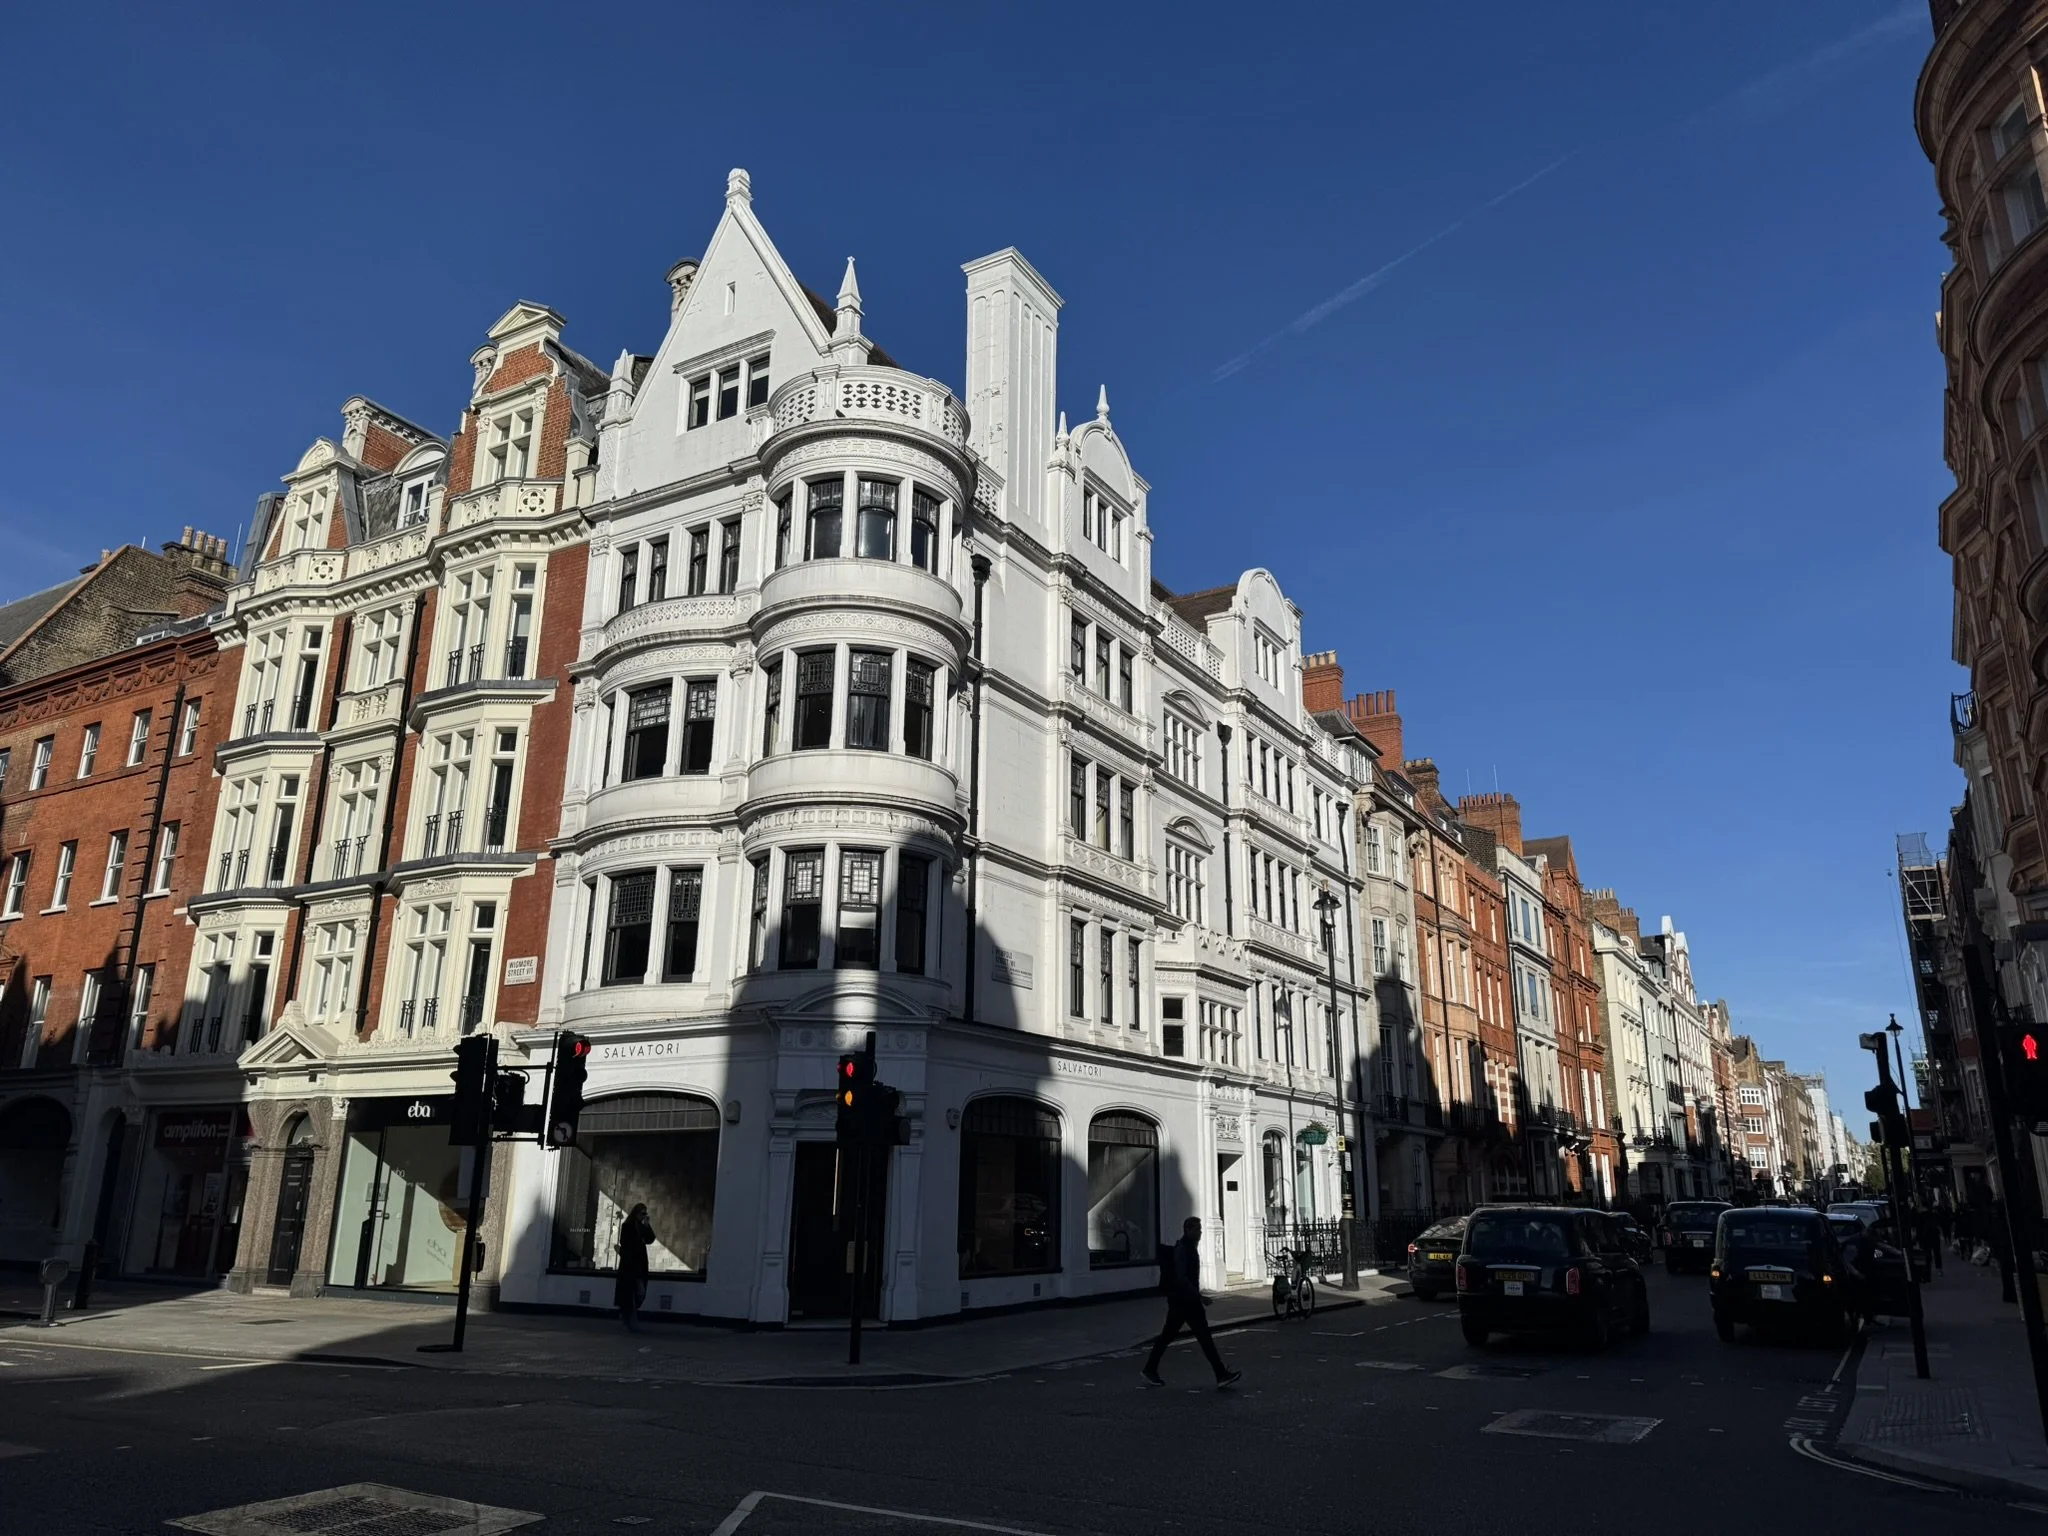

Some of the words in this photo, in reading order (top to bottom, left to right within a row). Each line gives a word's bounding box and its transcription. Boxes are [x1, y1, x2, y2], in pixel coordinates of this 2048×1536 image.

[509, 959, 533, 968] WIGMORE
[507, 967, 525, 977] STREET
[603, 1043, 680, 1059] SALVATORI
[1057, 1060, 1102, 1077] SALVATORI
[407, 1100, 431, 1118] eba
[163, 1120, 217, 1142] amplifon
